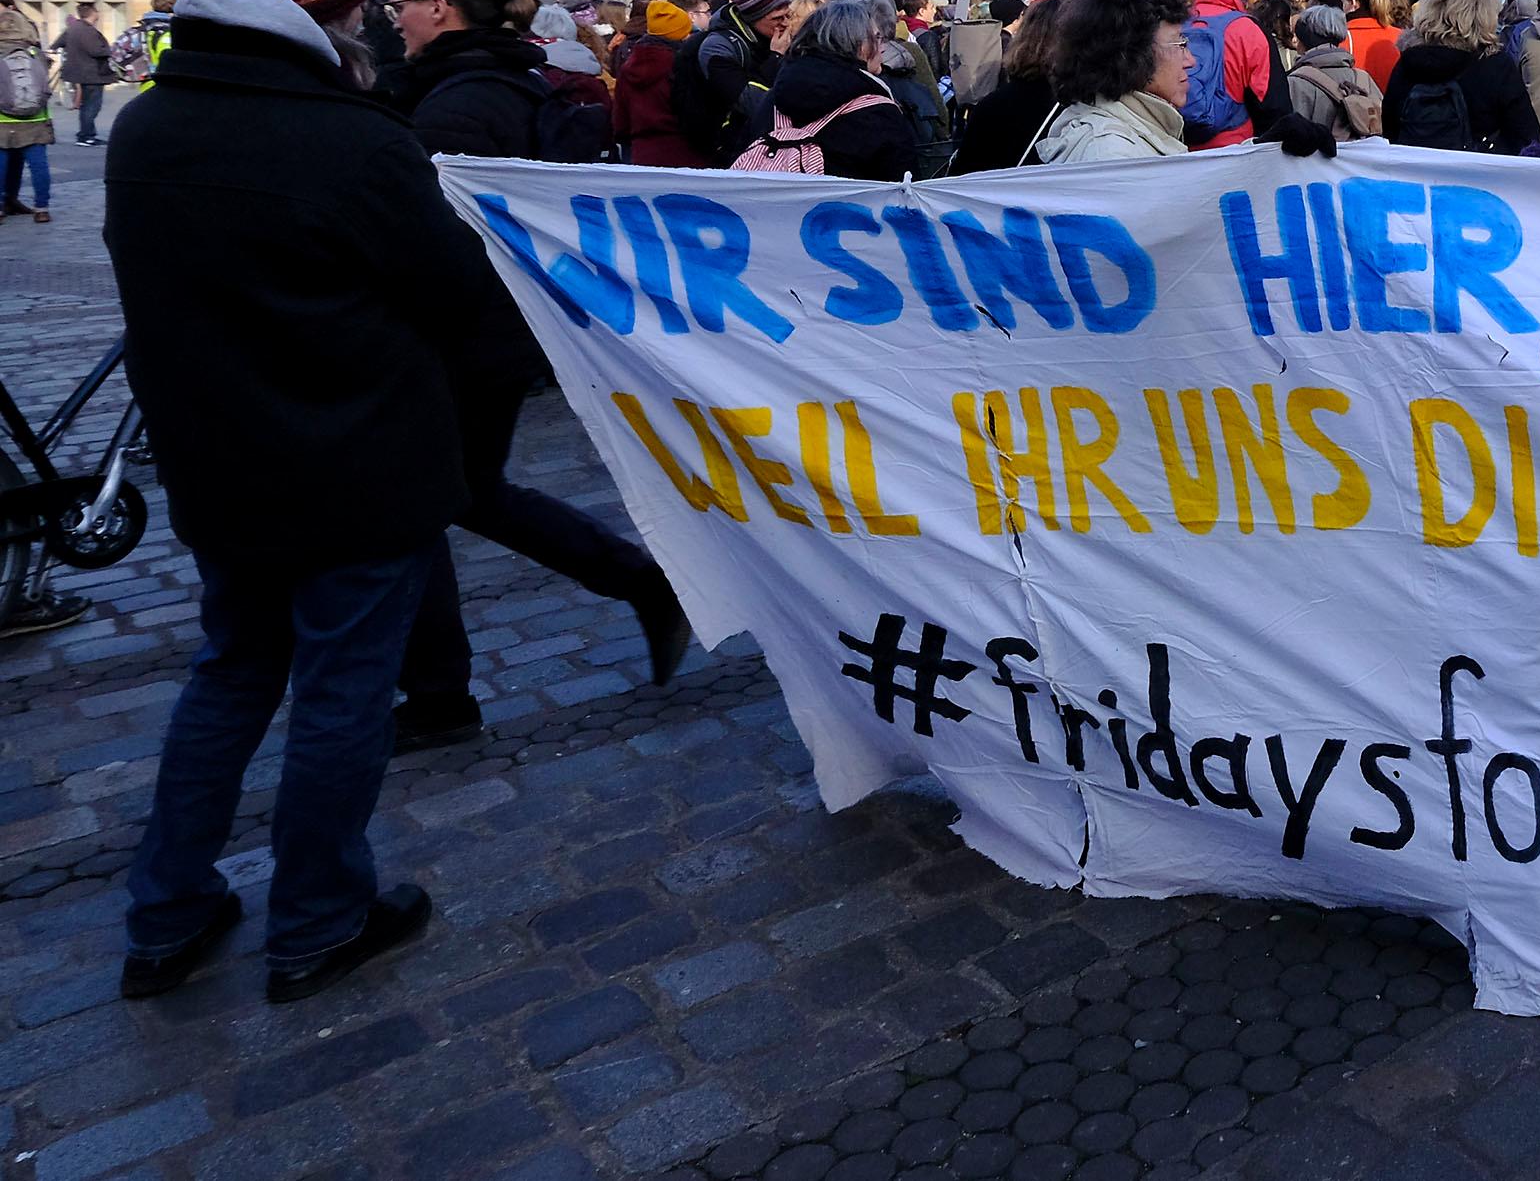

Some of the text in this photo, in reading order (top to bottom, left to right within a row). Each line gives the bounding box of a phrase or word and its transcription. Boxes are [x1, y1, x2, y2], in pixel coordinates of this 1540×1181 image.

[473, 192, 794, 343] WIR
[802, 202, 1157, 332] SIND
[611, 391, 920, 537] WEIL
[952, 386, 1150, 535] IHR
[1145, 383, 1371, 535] UNS
